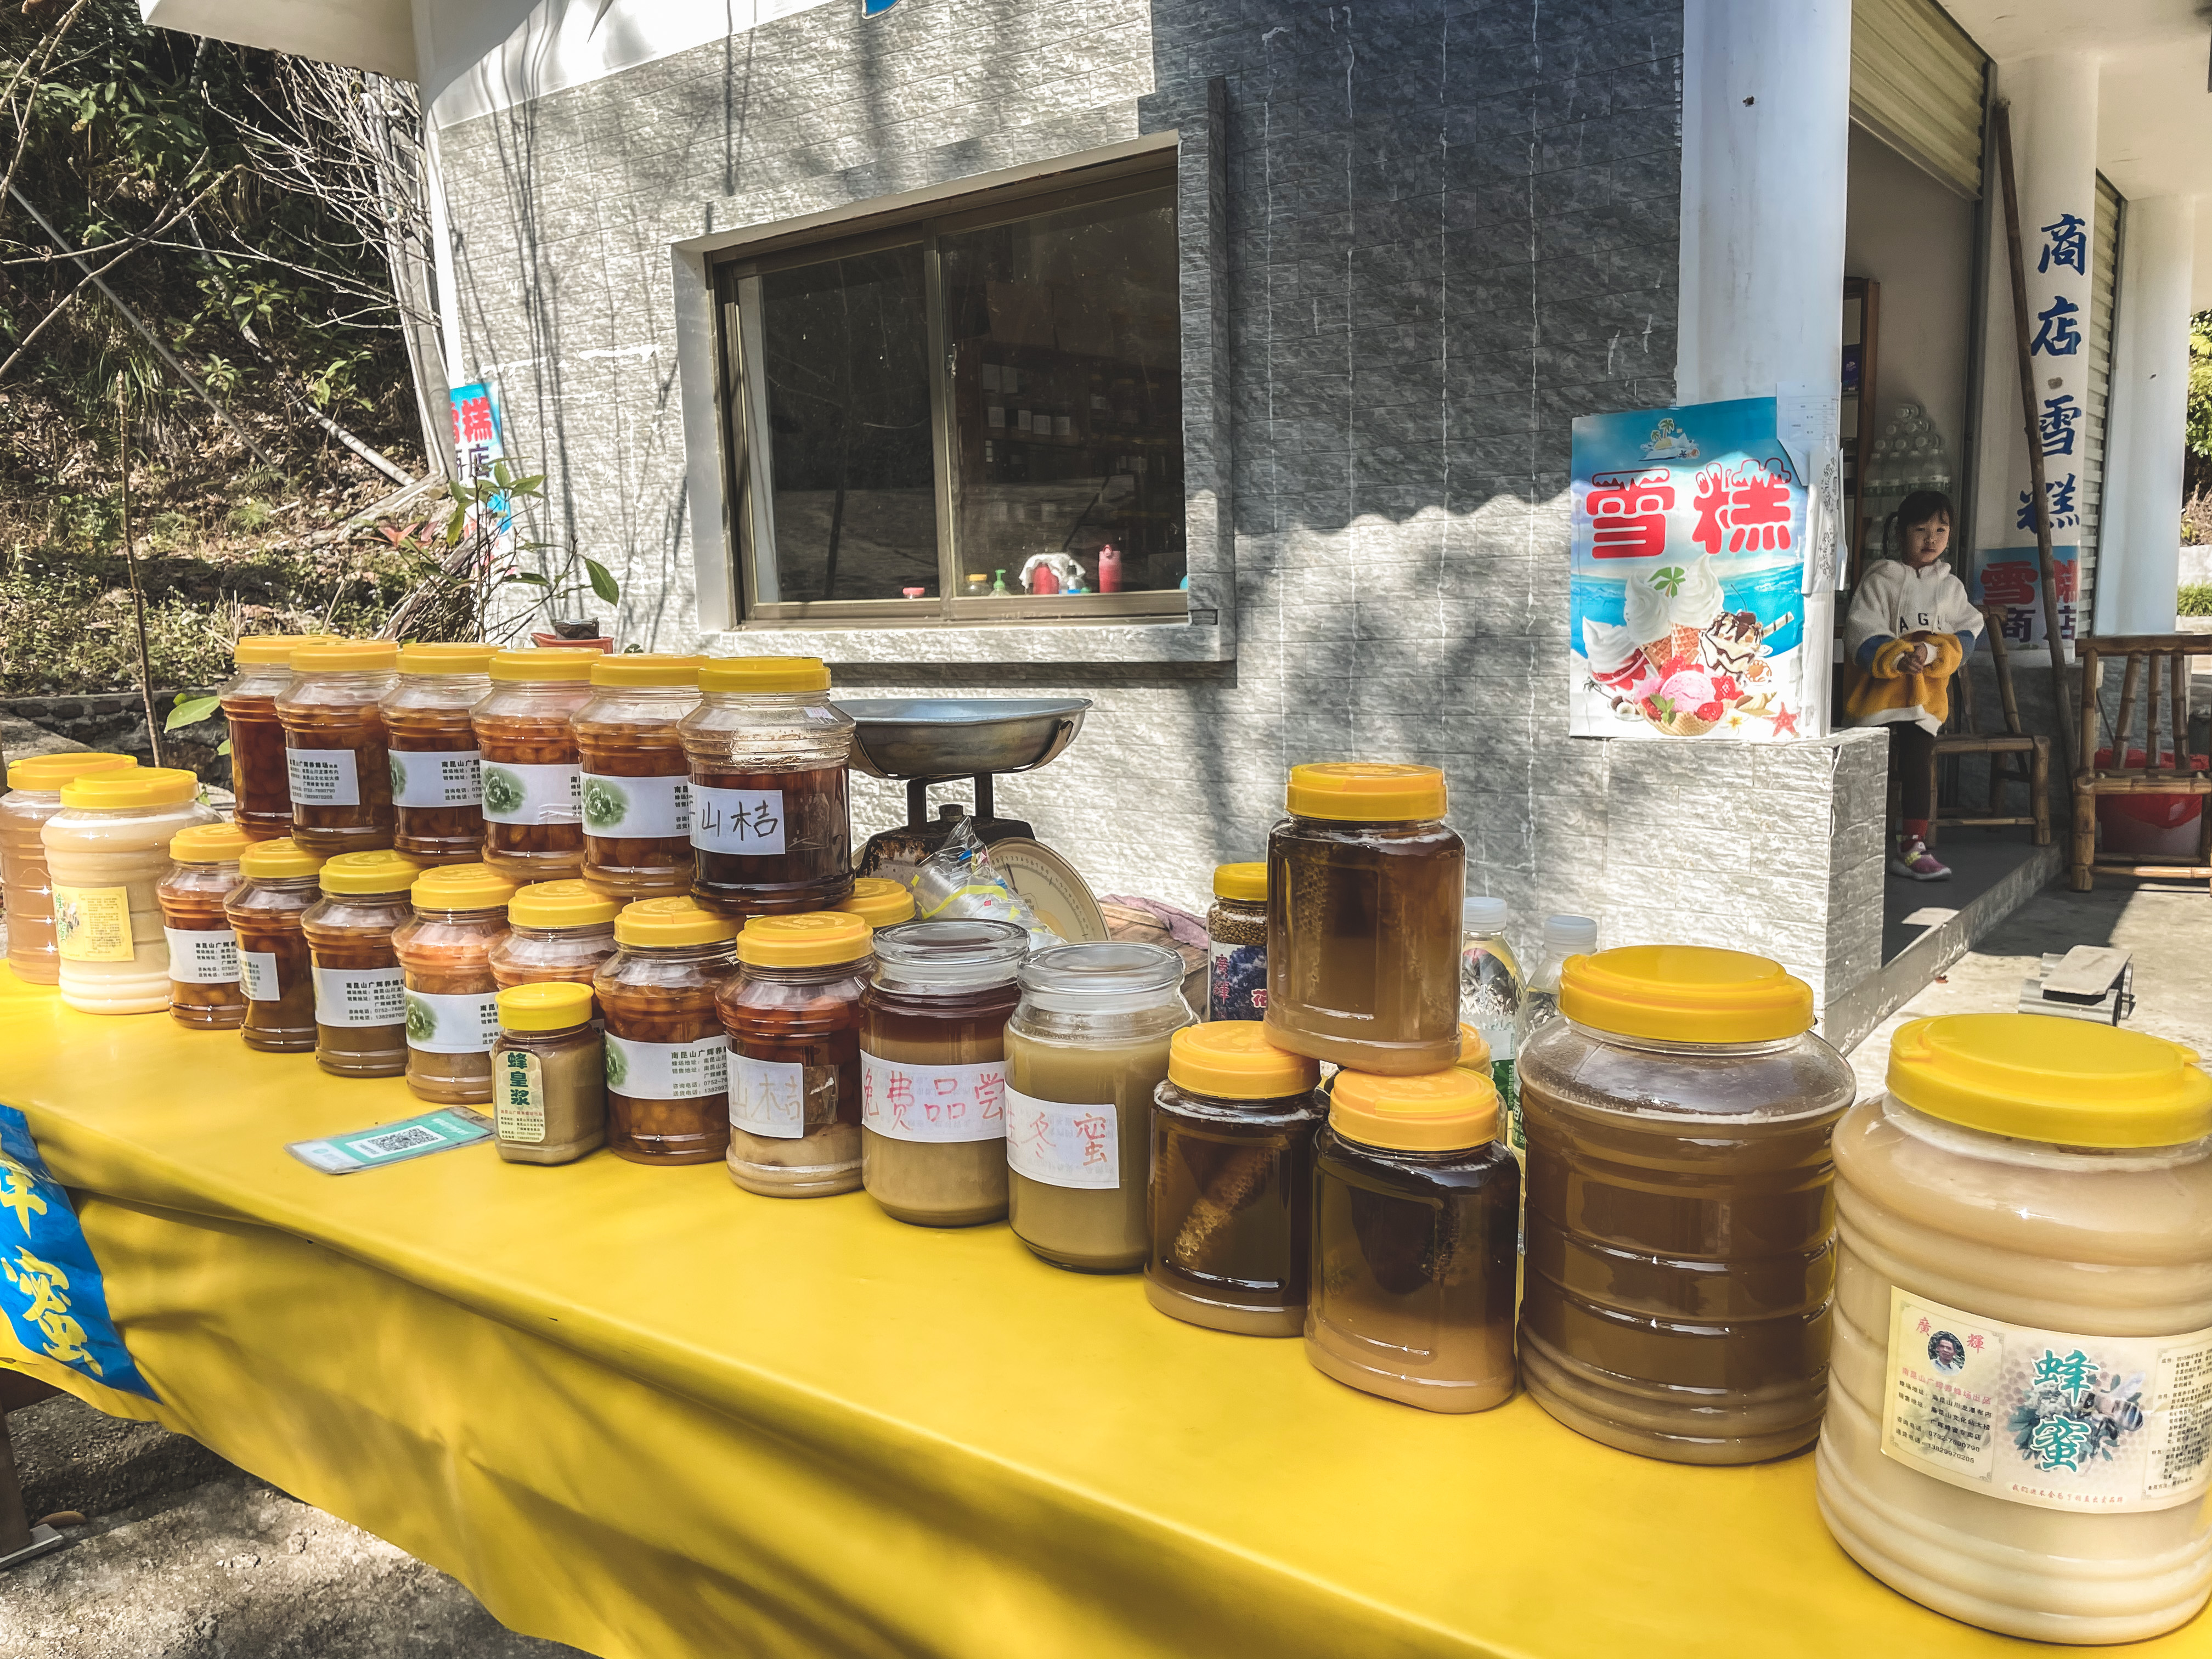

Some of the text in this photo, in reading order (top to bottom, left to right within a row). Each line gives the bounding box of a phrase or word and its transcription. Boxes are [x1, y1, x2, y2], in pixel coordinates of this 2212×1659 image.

[451, 397, 493, 444] 糕
[1587, 458, 1792, 559] 雪糕
[689, 795, 778, 841] 山桔
[507, 1052, 530, 1105] 蜂皇浆
[864, 1068, 1005, 1131] 免费品尝
[2029, 1348, 2101, 1473] 蜂蜜
